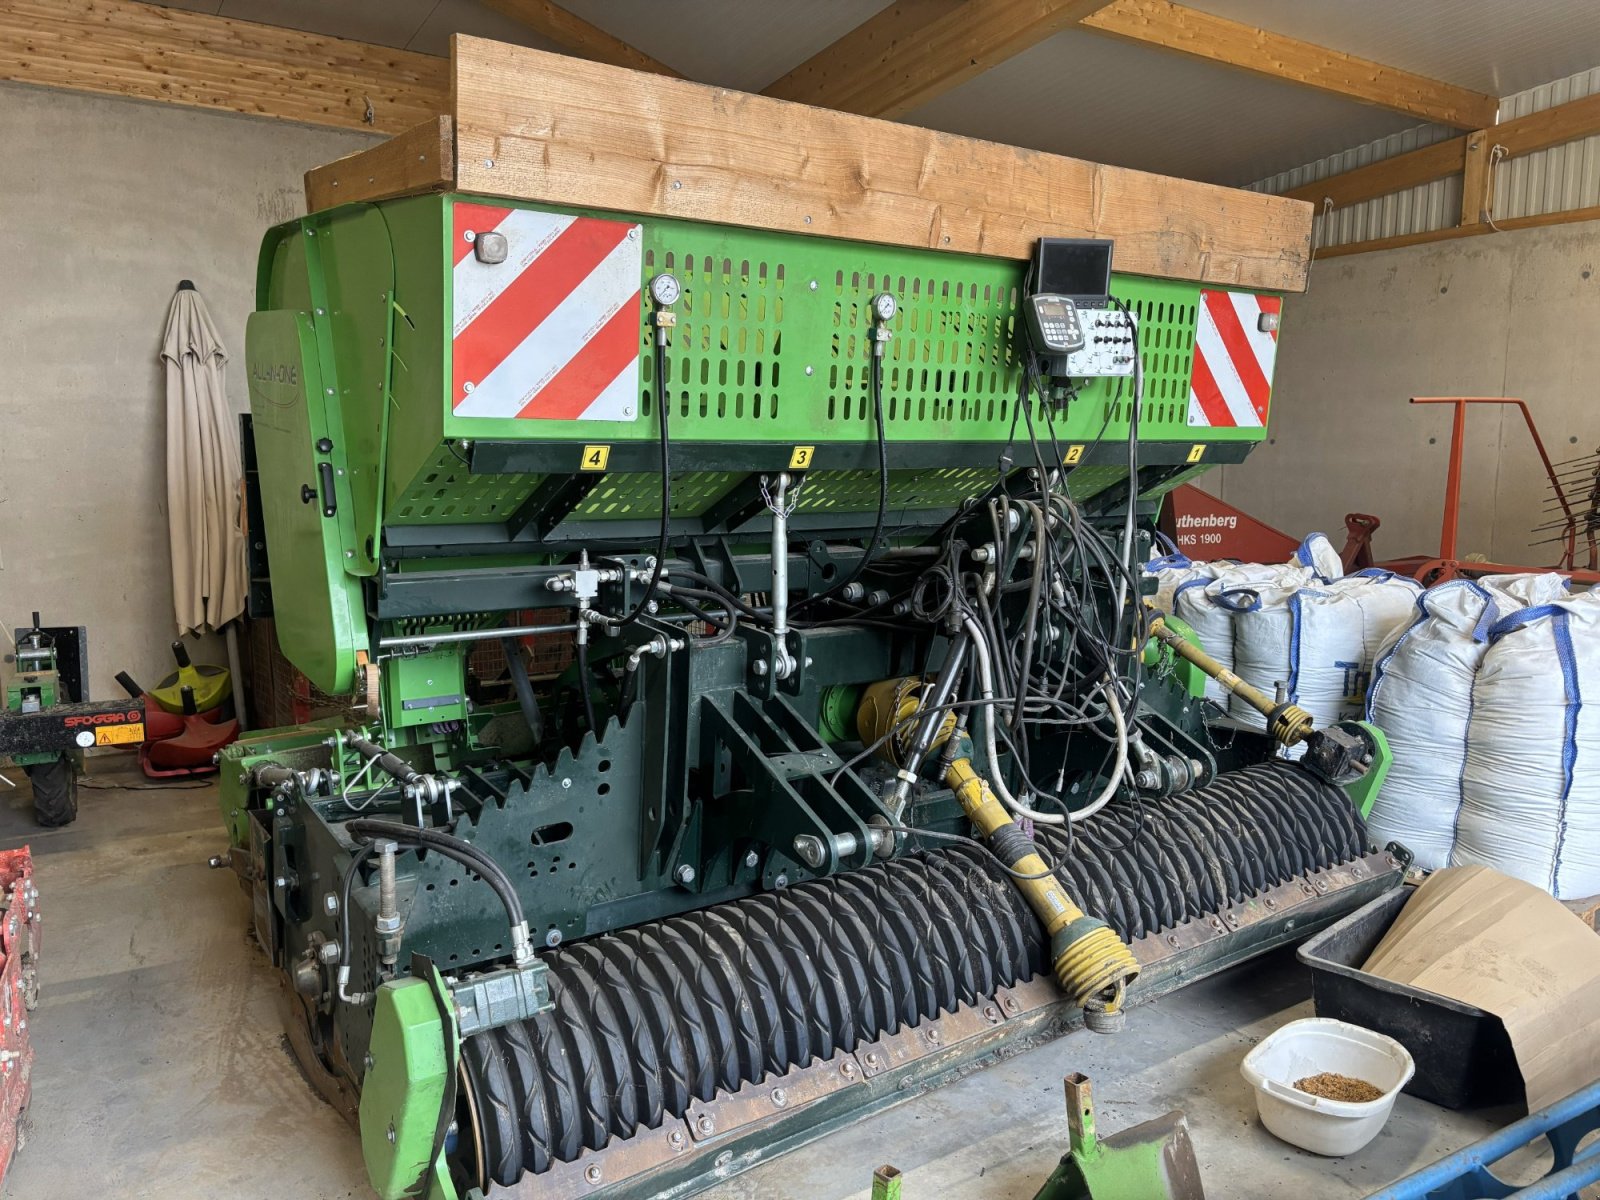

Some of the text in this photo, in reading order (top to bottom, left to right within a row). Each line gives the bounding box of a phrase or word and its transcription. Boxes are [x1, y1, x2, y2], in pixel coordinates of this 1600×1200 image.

[588, 450, 602, 466] 4
[796, 450, 807, 465] 3
[1068, 448, 1079, 461] 2
[1199, 533, 1222, 544] 1900
[64, 713, 126, 728] SFOGGIA
